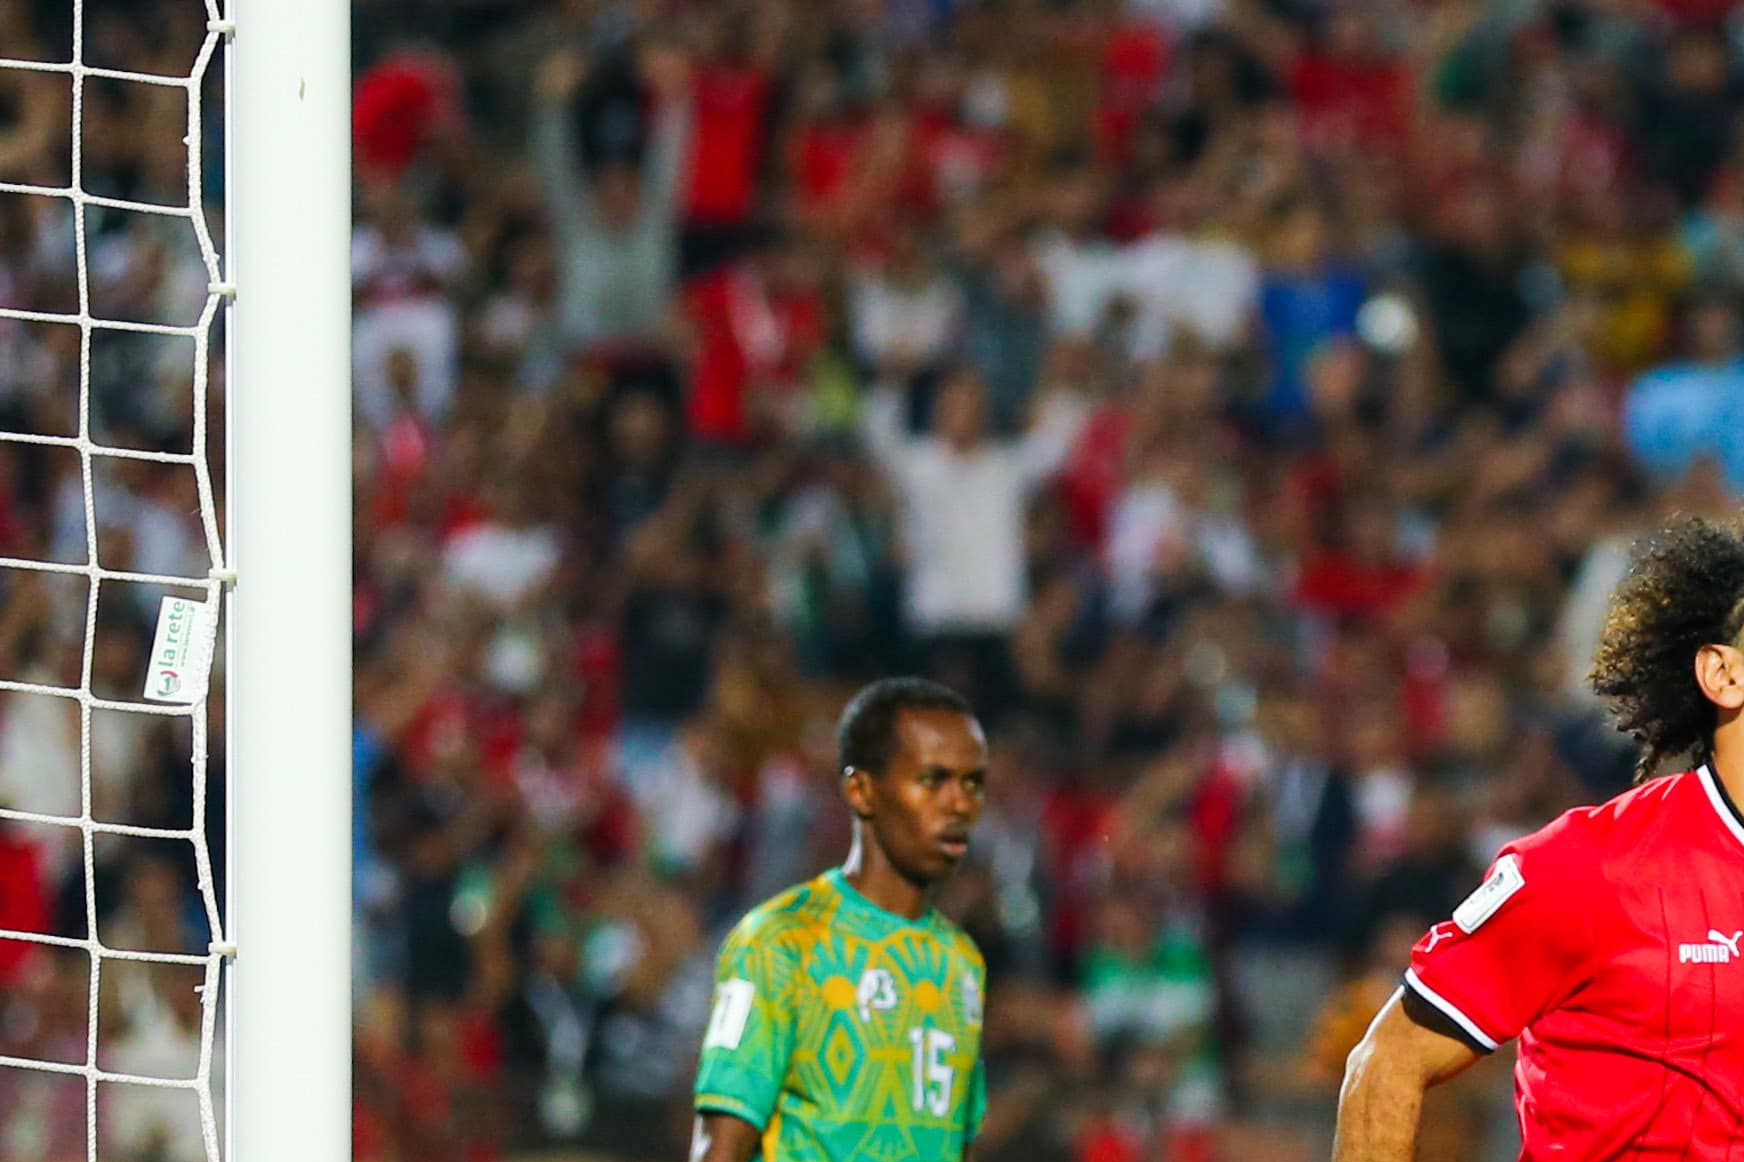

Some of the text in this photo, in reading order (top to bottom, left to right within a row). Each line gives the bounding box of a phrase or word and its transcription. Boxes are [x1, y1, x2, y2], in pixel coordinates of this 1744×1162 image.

[158, 601, 185, 667] la rete
[1679, 943, 1730, 963] PUMA
[909, 1027, 957, 1117] 15
